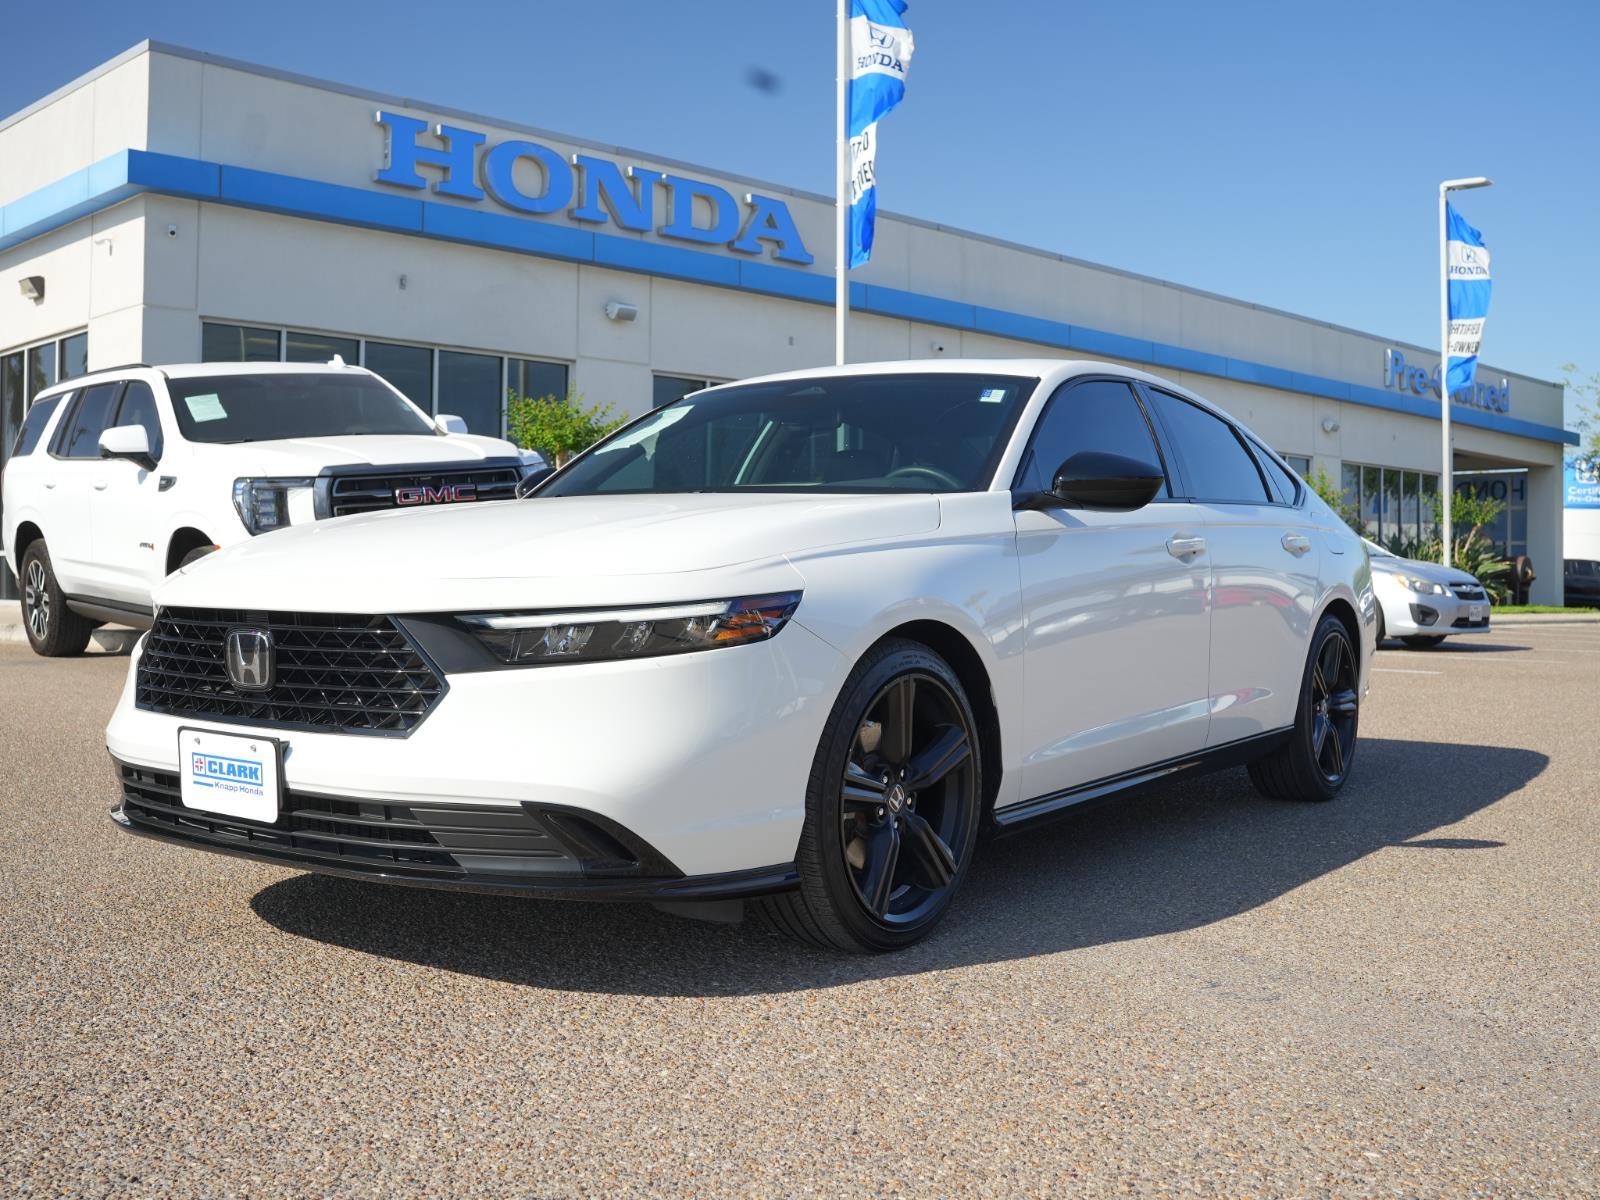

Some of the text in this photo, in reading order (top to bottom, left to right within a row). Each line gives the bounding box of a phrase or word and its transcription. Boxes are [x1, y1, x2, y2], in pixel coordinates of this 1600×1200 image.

[857, 52, 904, 73] HONDA
[373, 110, 814, 265] HONDA
[395, 484, 477, 505] GMC
[208, 760, 259, 780] CLARK
[214, 781, 264, 796] Knapp Honda
